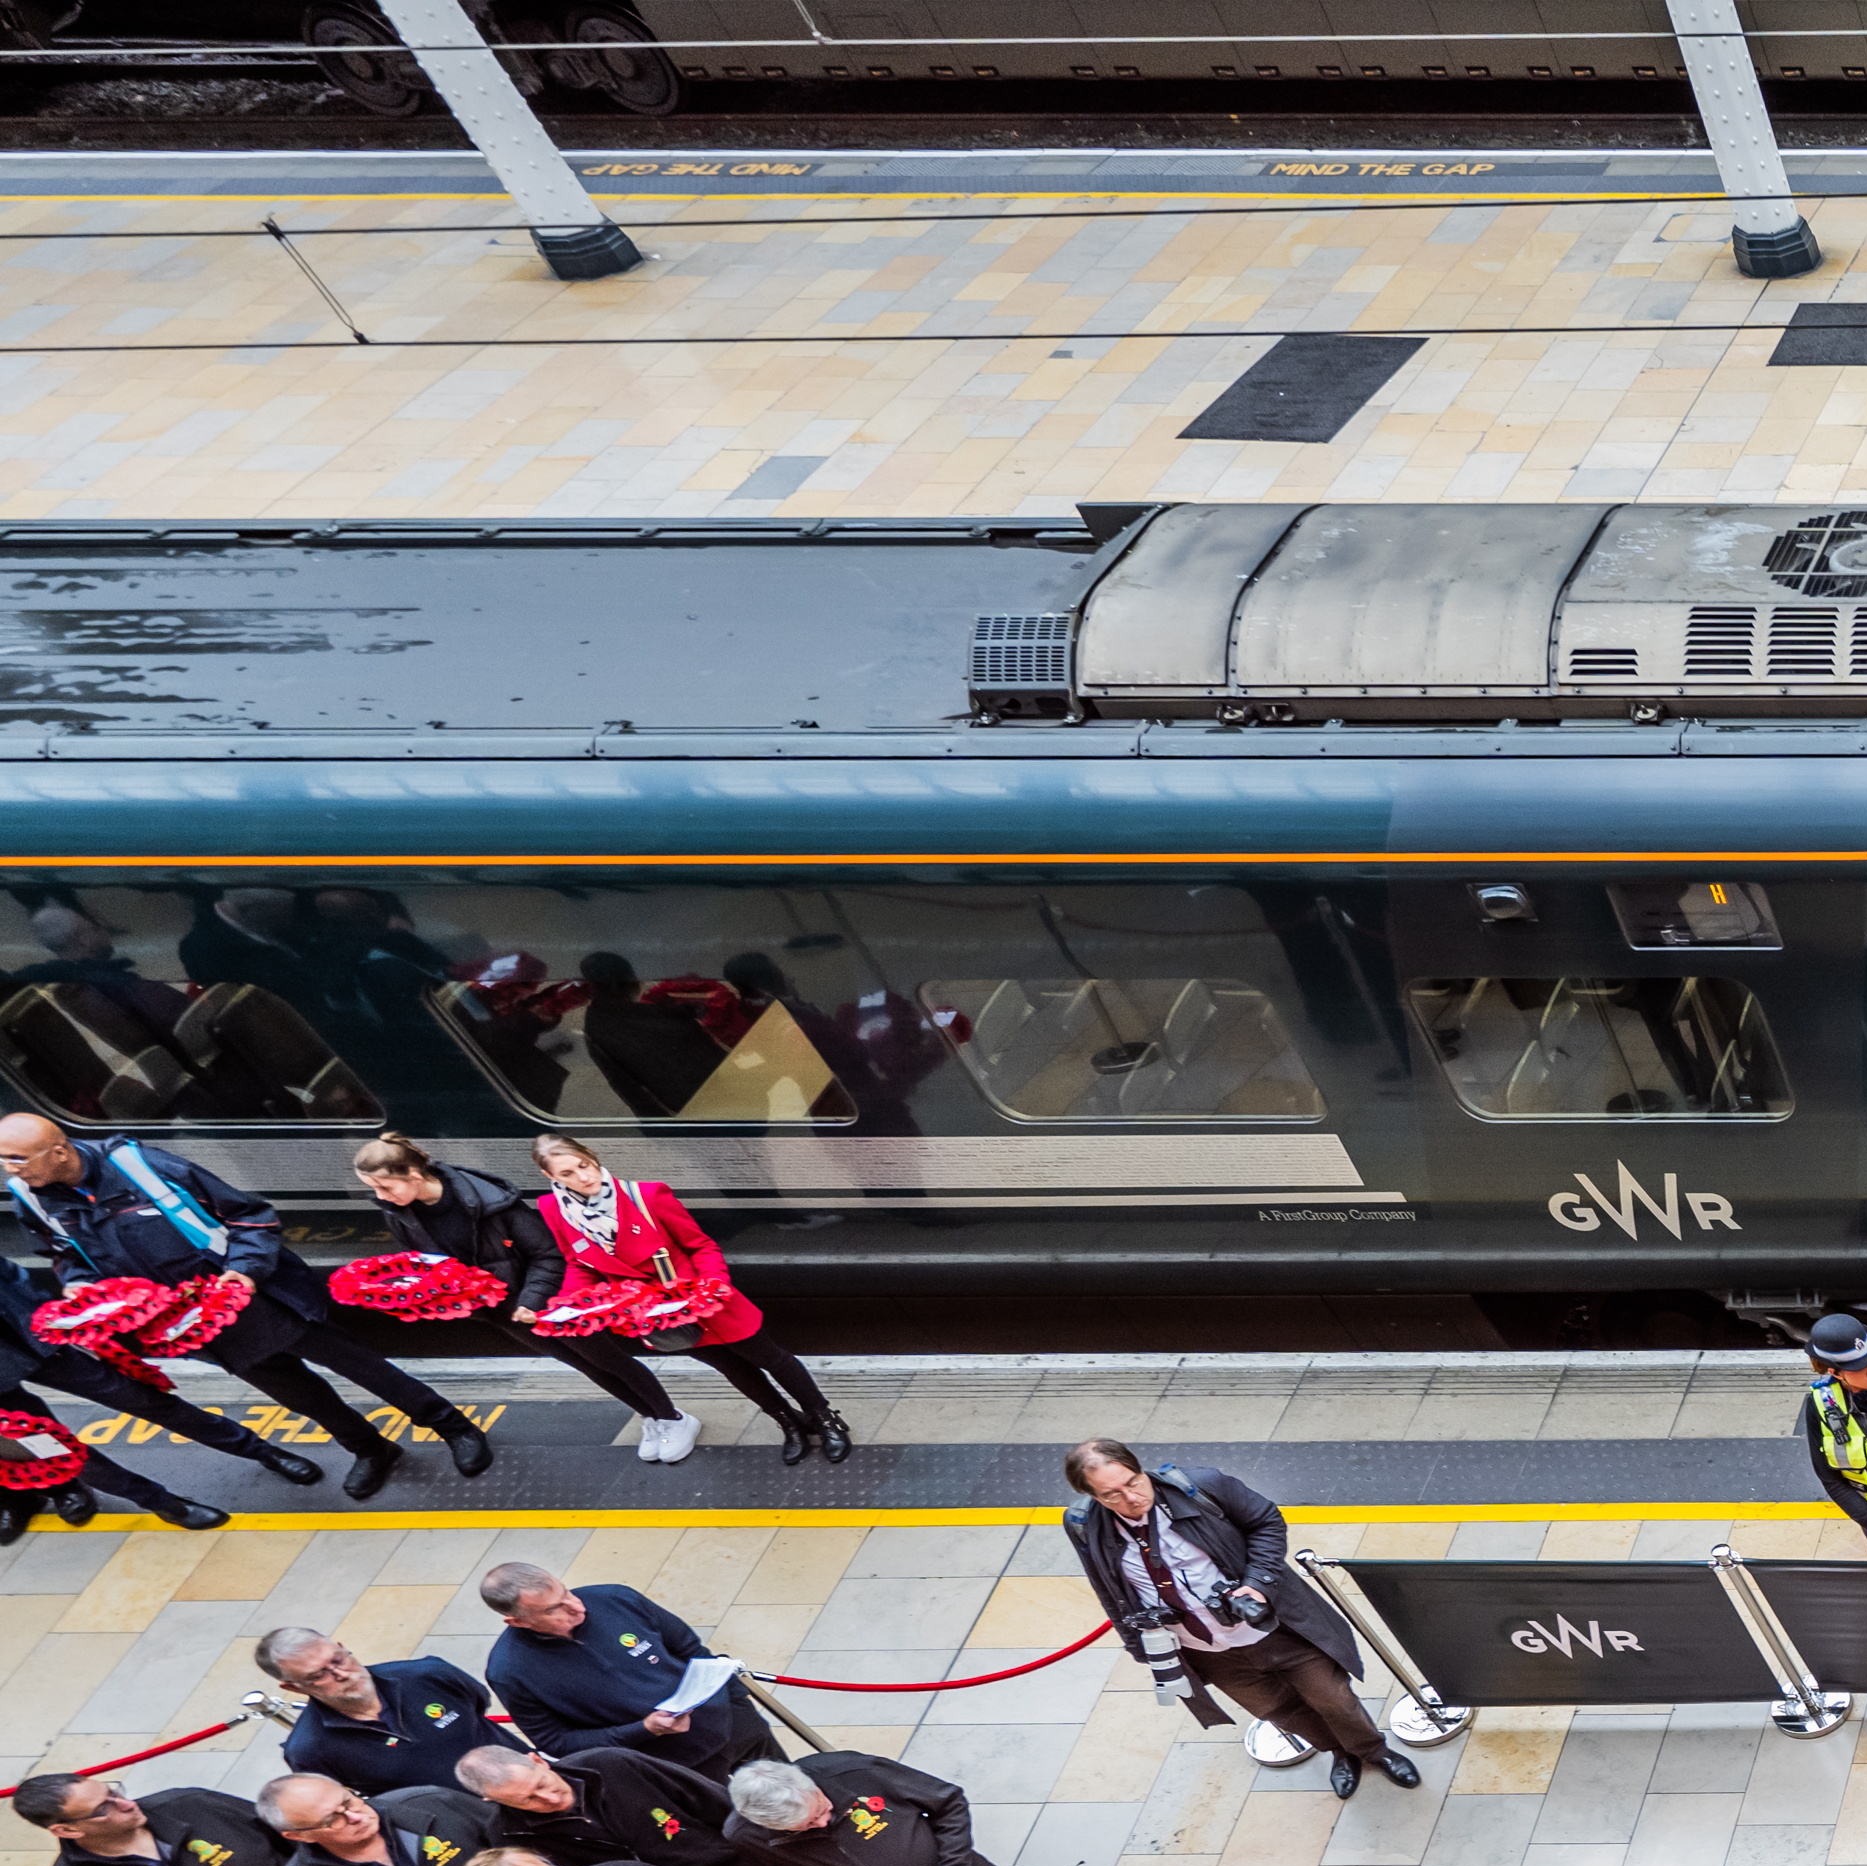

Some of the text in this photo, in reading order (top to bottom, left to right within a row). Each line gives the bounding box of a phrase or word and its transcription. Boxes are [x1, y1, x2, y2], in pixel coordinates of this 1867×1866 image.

[581, 163, 811, 176] MIND THE GAP
[1270, 163, 1496, 176] MIND THE GAP
[1709, 883, 1728, 904] H
[1548, 1159, 1743, 1242] GWR
[1259, 1208, 1417, 1222] A FirstGroup Company
[1510, 1612, 1645, 1660] GWR
